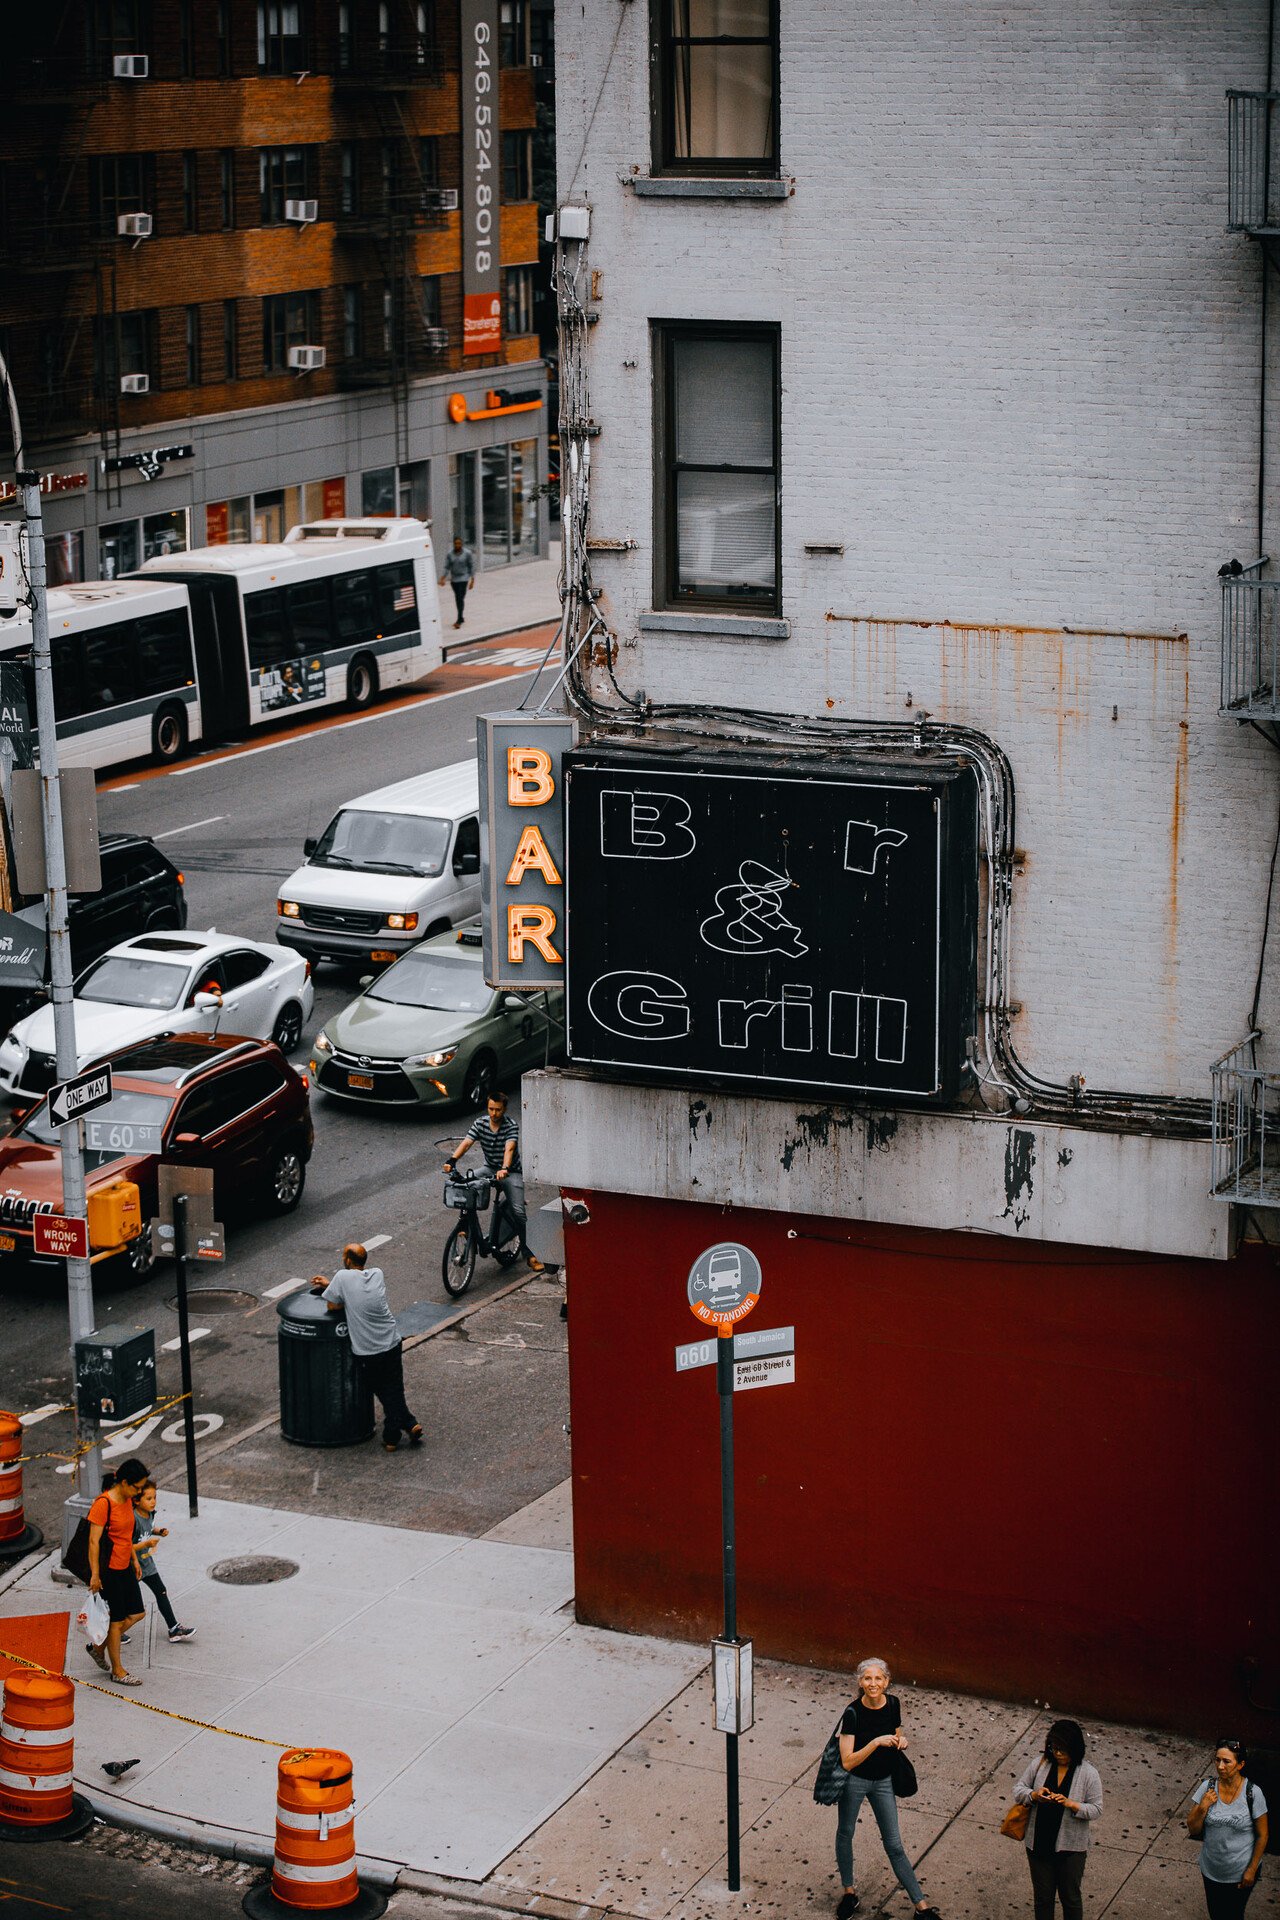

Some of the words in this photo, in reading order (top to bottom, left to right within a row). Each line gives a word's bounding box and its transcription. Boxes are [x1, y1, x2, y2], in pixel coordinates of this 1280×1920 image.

[474, 21, 492, 274] 646.524.8018
[505, 746, 563, 964] BAR
[700, 860, 810, 959] &
[587, 970, 908, 1065] Grill
[66, 1088, 84, 1109] ONE
[87, 1078, 106, 1099] WAY
[90, 1123, 103, 1146] E
[109, 1125, 134, 1149] 60
[138, 1126, 153, 1139] ST
[43, 1228, 78, 1243] WRONG
[50, 1240, 72, 1252] WAY
[697, 1305, 711, 1319] NO
[711, 1298, 755, 1323] STANDING
[737, 1336, 756, 1346] South
[757, 1331, 786, 1343] Jamaica
[679, 1344, 710, 1367] Q60
[737, 1365, 752, 1375] East
[763, 1360, 784, 1370] Street
[785, 1359, 791, 1367] &
[737, 1376, 742, 1385] 2
[743, 1373, 768, 1384] Avenue
